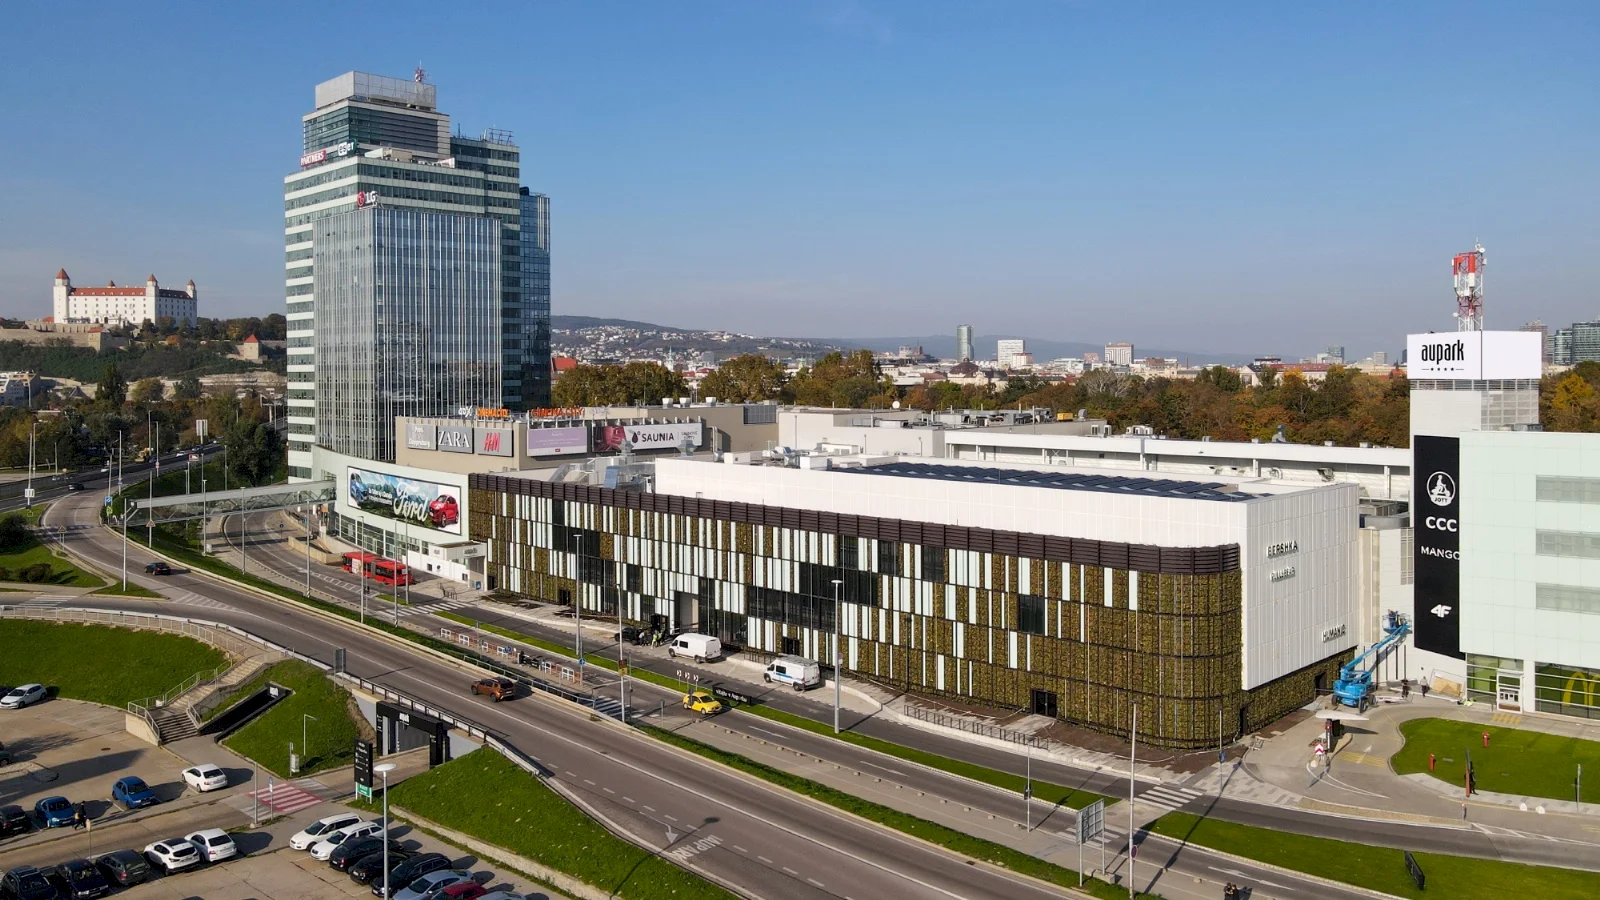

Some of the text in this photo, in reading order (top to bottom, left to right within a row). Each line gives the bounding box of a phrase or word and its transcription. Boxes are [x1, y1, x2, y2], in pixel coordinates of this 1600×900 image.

[301, 151, 326, 166] PARTNERS
[1421, 340, 1464, 365] aupark
[438, 431, 470, 448] ZARA
[641, 432, 675, 443] SAUNIA
[393, 481, 429, 521] Ford
[1425, 516, 1457, 532] CCC
[1266, 540, 1298, 557] BERSHKA
[1430, 604, 1452, 618] 4F
